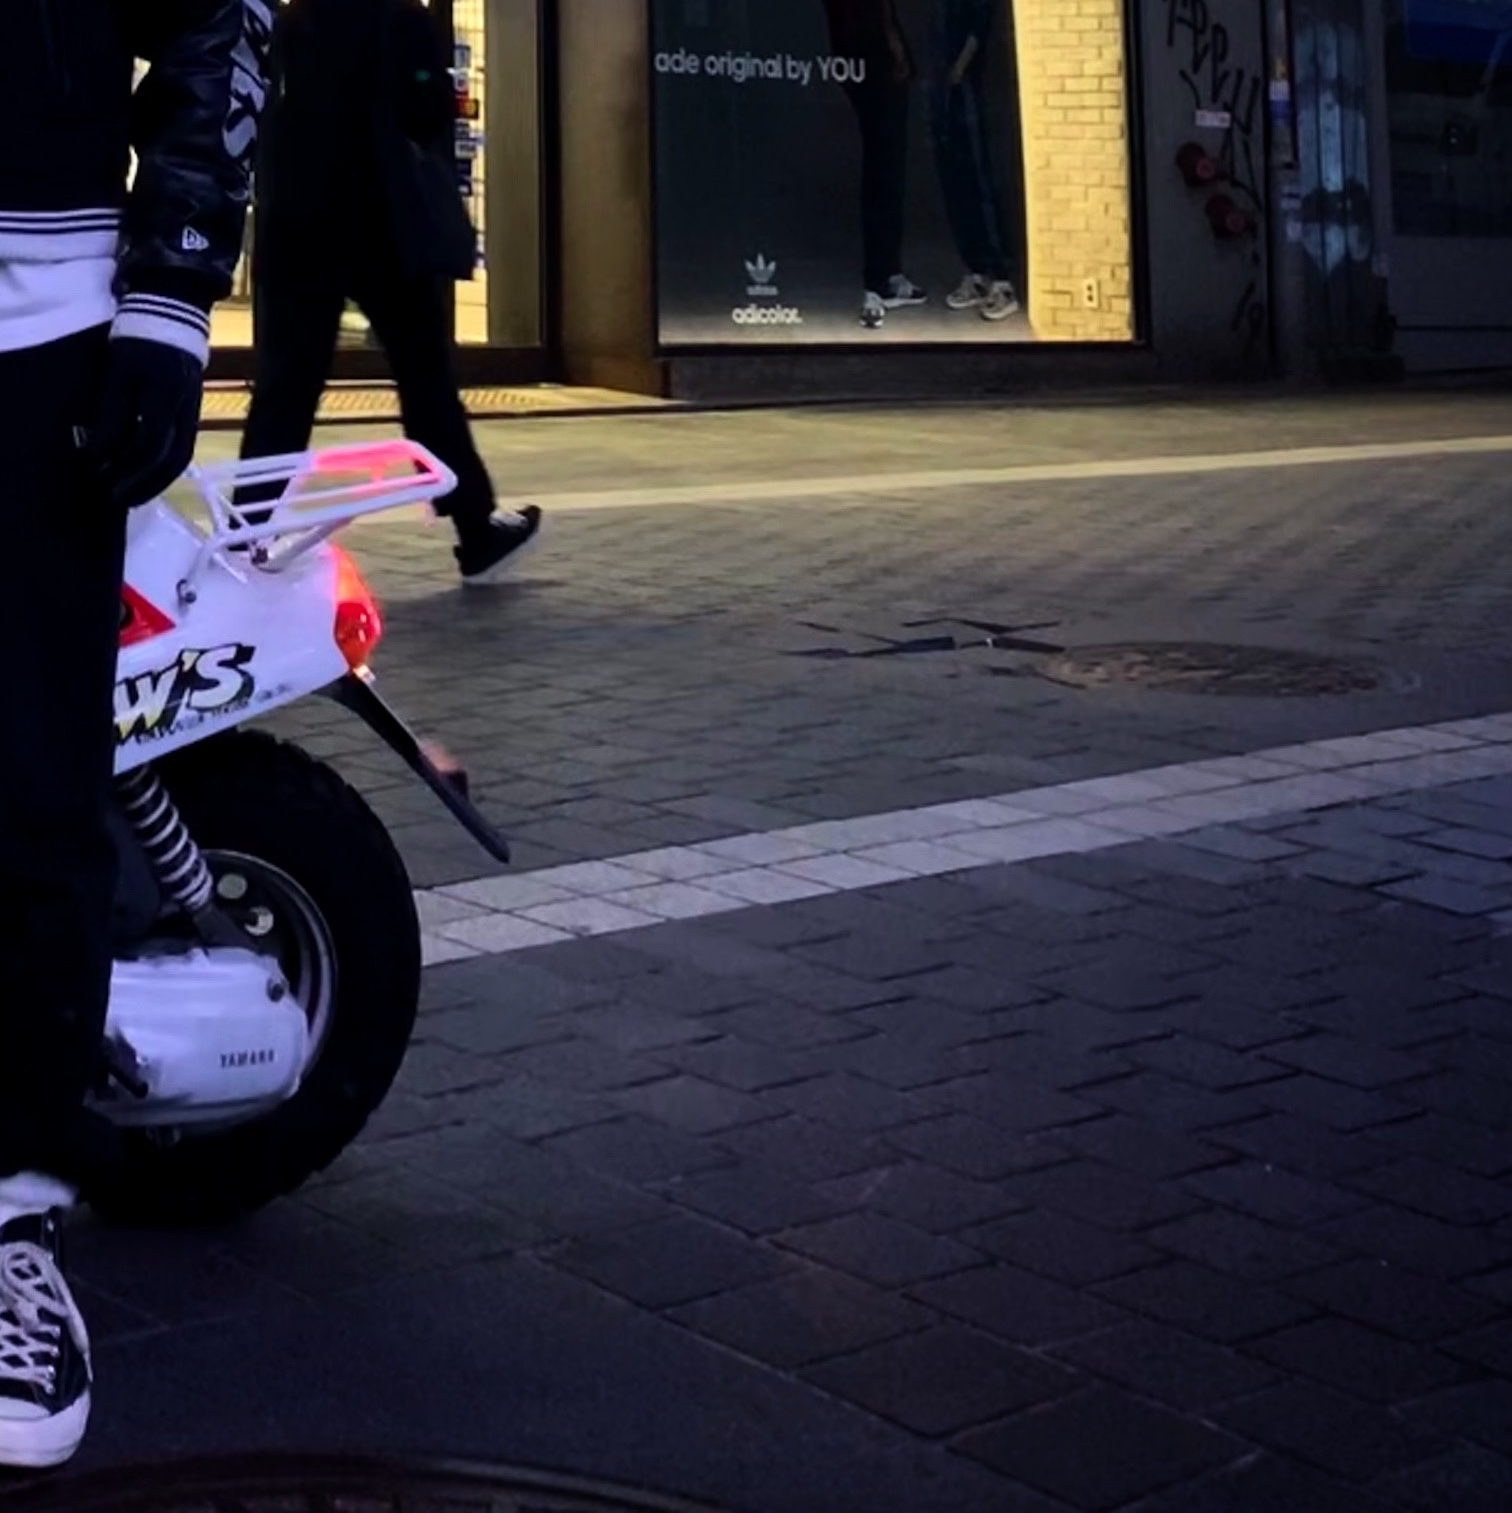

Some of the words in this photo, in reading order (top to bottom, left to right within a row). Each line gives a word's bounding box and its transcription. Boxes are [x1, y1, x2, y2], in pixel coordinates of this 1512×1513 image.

[704, 51, 783, 83] original
[787, 54, 813, 86] by
[817, 55, 866, 83] YOU
